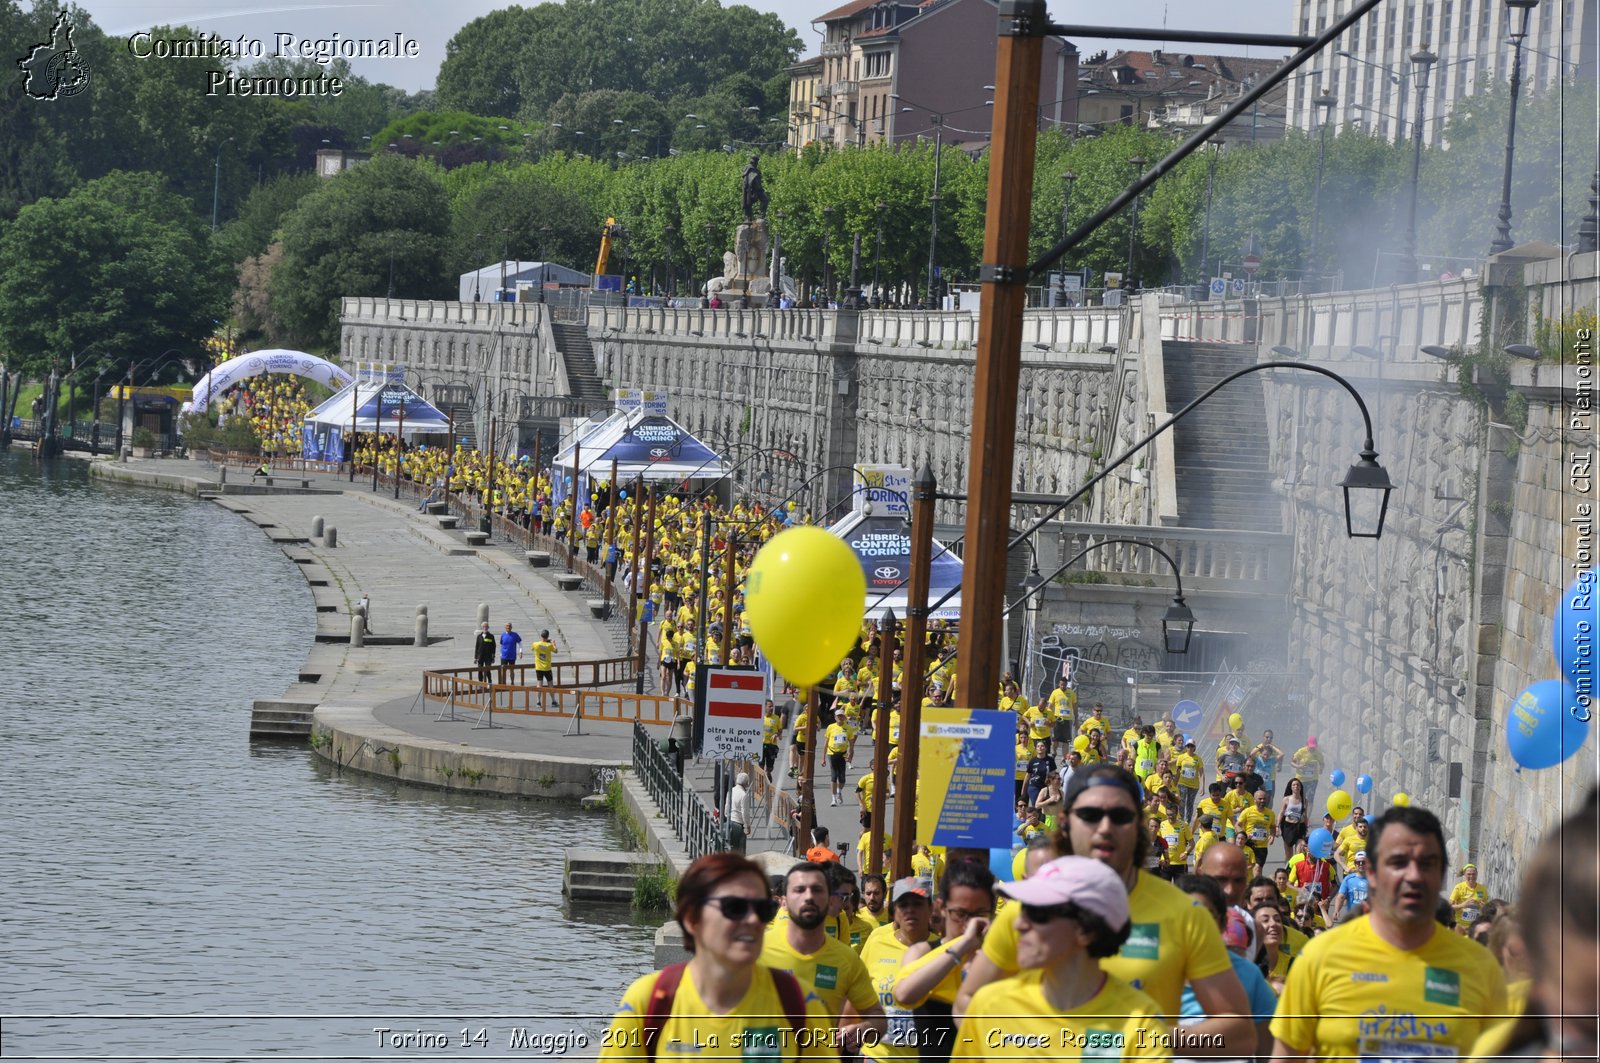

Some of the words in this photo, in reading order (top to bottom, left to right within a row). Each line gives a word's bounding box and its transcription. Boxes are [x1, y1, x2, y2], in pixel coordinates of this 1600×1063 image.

[885, 474, 907, 487] Stra
[865, 490, 908, 503] TORINO
[707, 727, 726, 735] oltre
[738, 728, 760, 736] ponte
